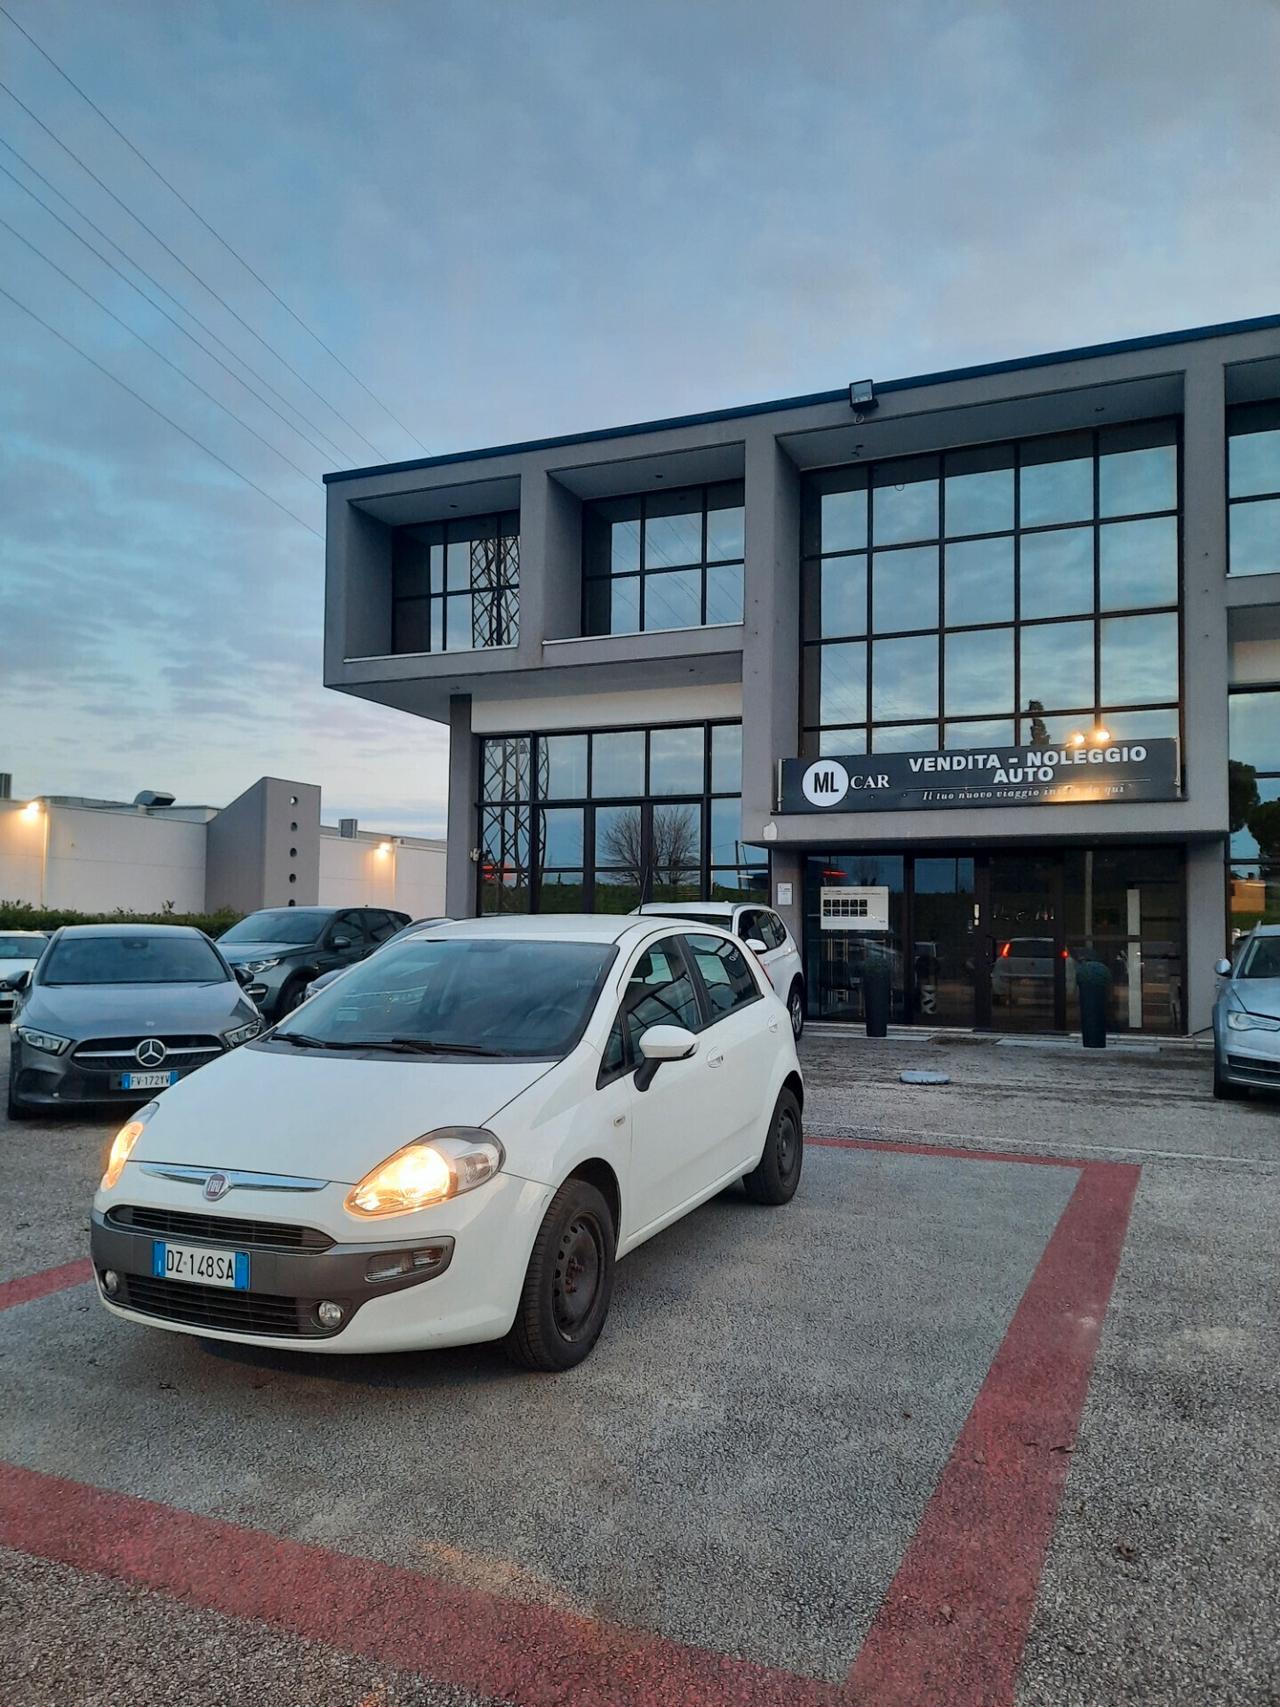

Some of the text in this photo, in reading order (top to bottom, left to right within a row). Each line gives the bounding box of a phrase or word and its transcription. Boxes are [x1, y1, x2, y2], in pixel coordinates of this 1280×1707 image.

[909, 754, 1001, 773] VENDITA
[1026, 746, 1148, 767] NOLEGGIO
[814, 771, 891, 794] ML CAR
[992, 766, 1054, 784] AUTO
[922, 791, 933, 801] Il
[936, 791, 955, 801] tuo
[958, 790, 993, 800] nuovo
[996, 786, 1041, 801] viaggio
